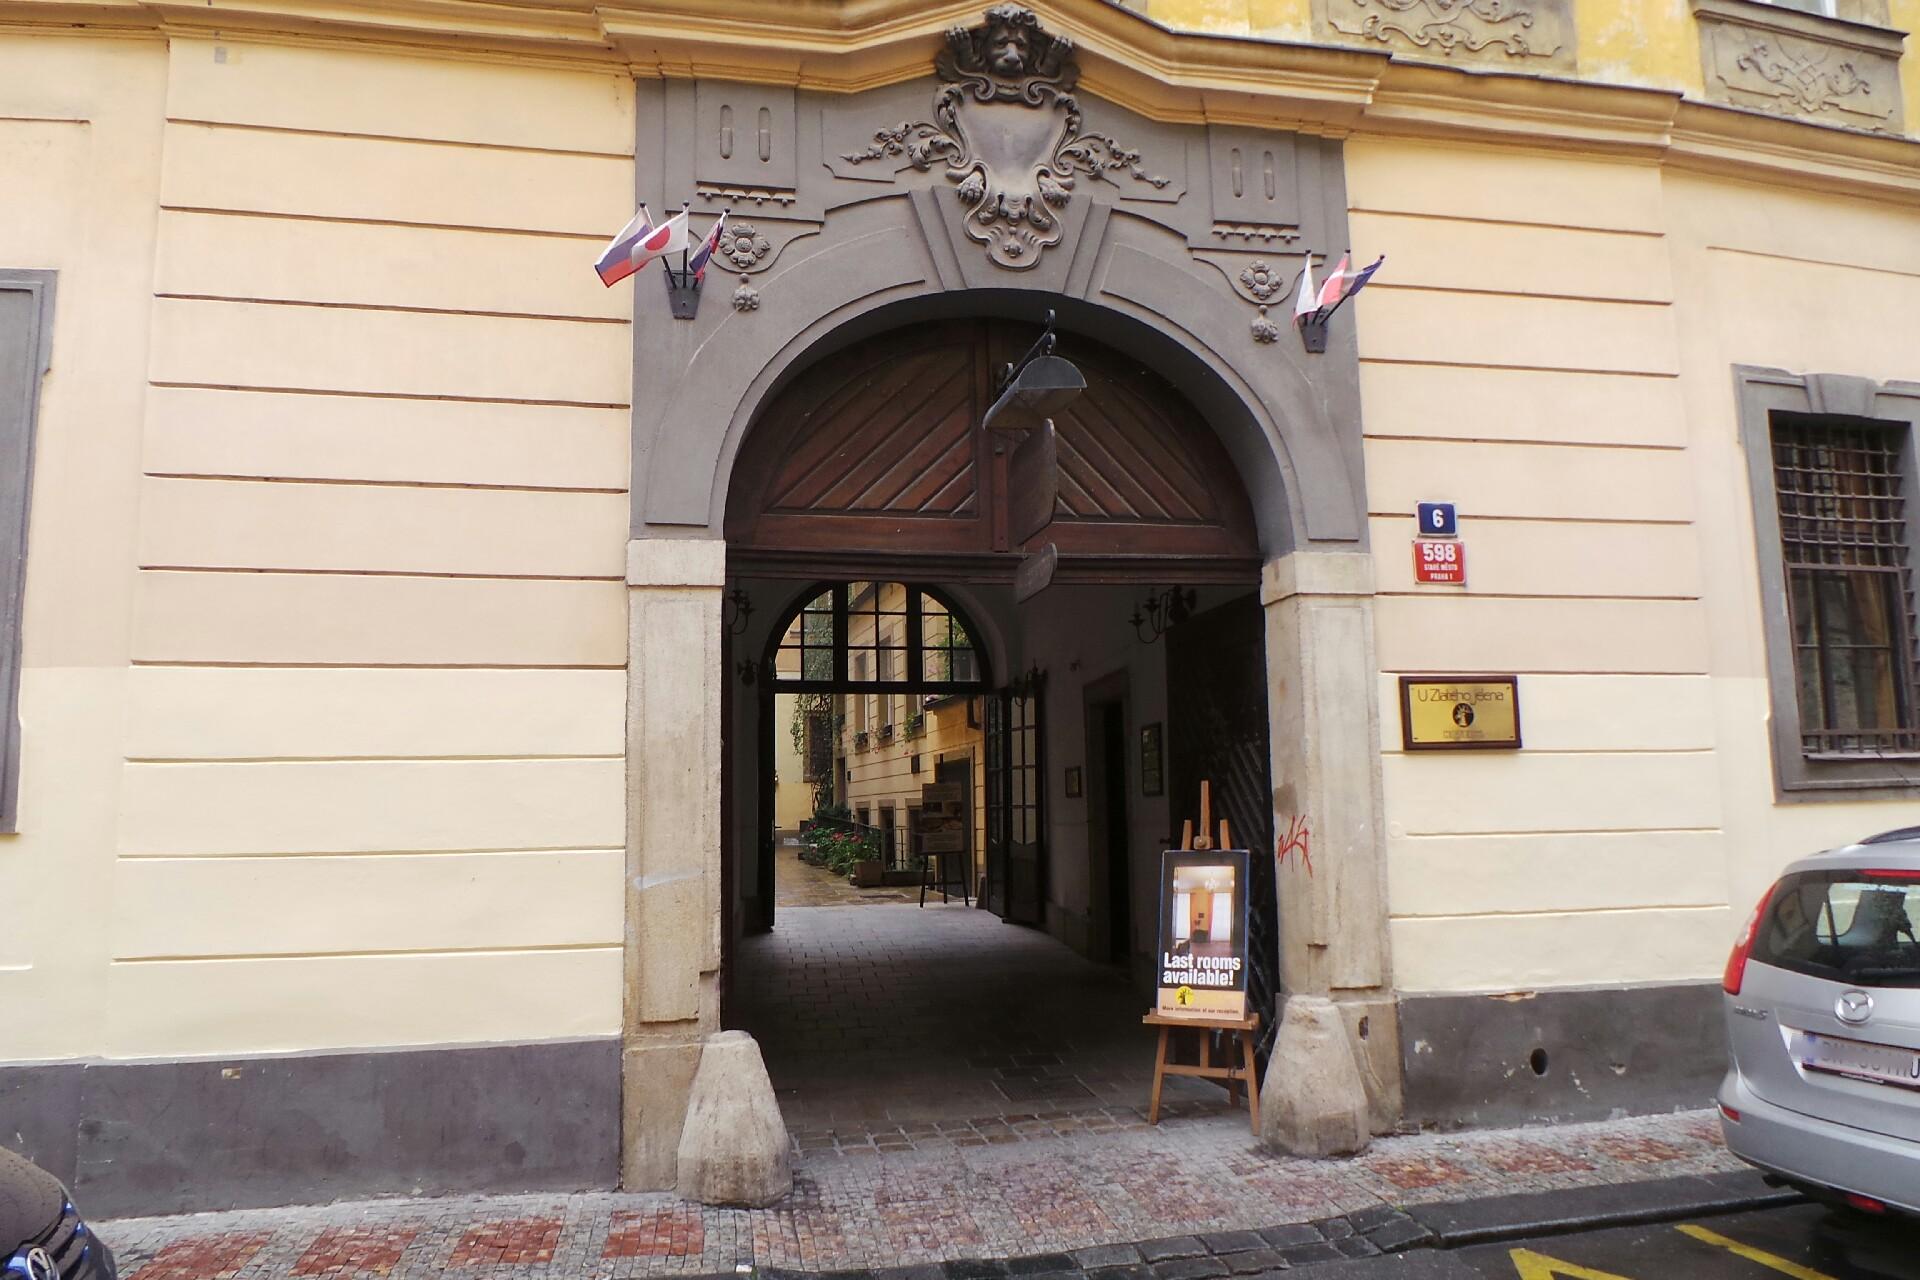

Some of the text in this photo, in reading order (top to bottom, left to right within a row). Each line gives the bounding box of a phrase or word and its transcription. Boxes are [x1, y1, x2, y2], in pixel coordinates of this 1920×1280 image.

[1432, 509, 1444, 528] 6
[1422, 543, 1456, 562] 598
[1430, 572, 1448, 580] PRAHA
[1418, 688, 1428, 702] U
[1164, 952, 1241, 971] Last rooms
[1162, 969, 1234, 986] available!
